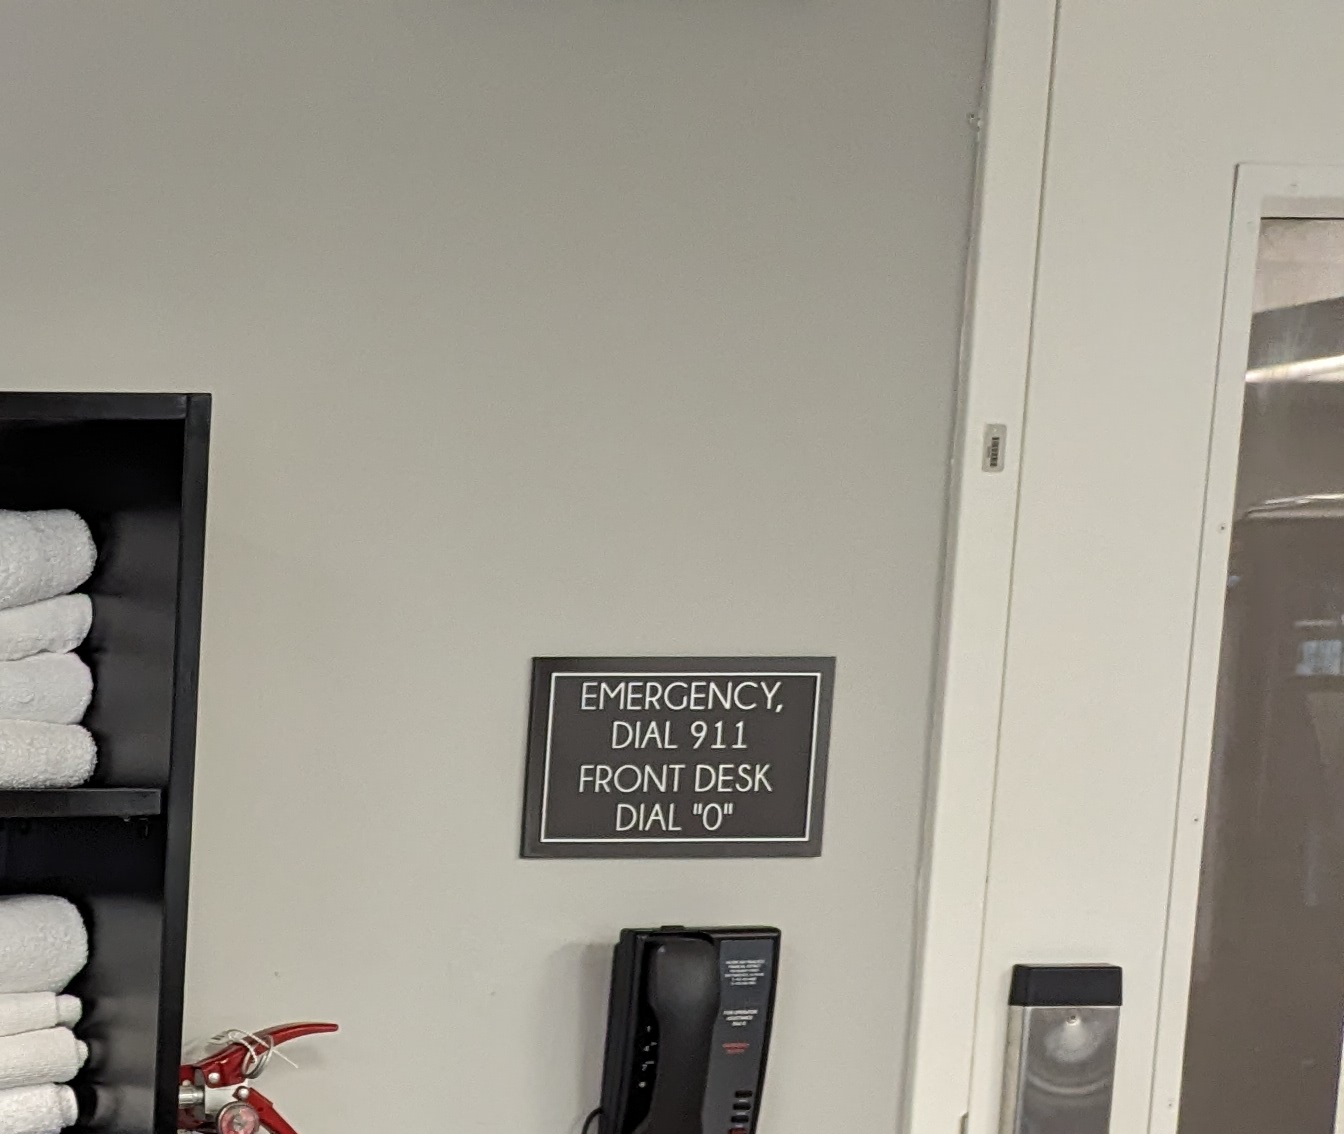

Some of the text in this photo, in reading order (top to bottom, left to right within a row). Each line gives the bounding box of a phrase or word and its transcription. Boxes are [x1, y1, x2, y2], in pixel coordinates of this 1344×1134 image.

[581, 681, 784, 713] EMERGENCY,
[612, 720, 748, 749] DIAL 911
[579, 763, 773, 792] FRONT DESK
[615, 802, 682, 831] DIAL
